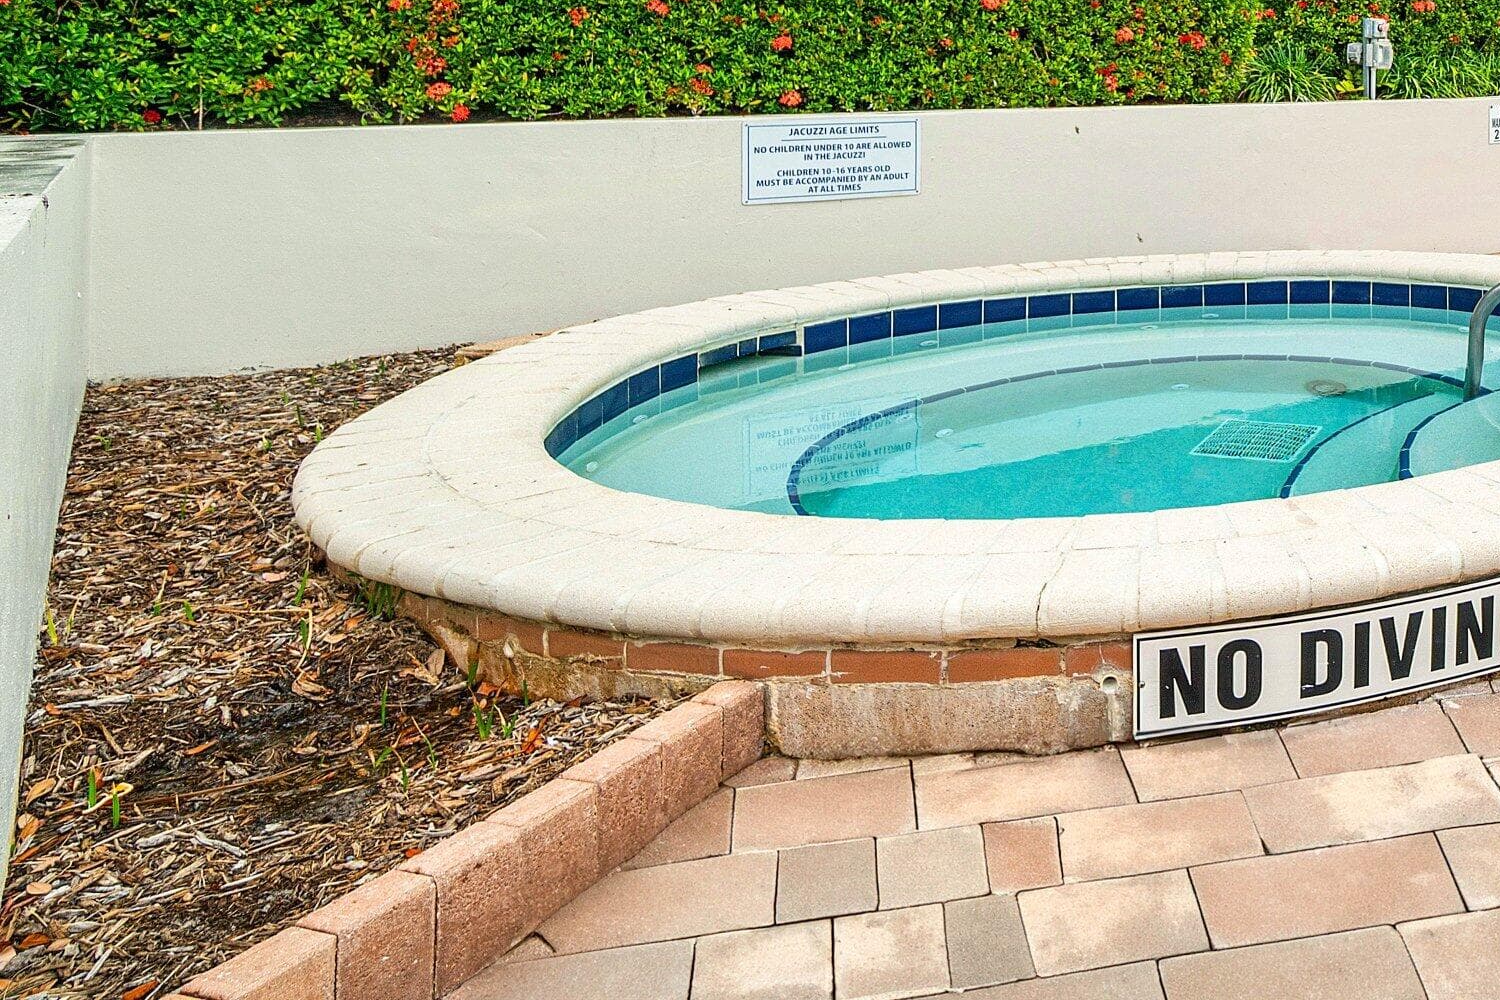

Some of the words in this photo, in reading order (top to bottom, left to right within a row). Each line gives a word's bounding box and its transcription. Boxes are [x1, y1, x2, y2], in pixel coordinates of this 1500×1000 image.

[789, 128, 827, 136] JACUZZI
[829, 127, 847, 135] AGE
[850, 126, 880, 134] LIMITS
[1494, 129, 1500, 140] 2
[769, 144, 812, 153] CHILDREN
[813, 144, 842, 152] UNDER
[873, 141, 912, 149] ALLOWED
[832, 151, 865, 159] JACUZZI
[777, 168, 819, 177] CHILDREN
[756, 179, 781, 187] MUST
[783, 178, 793, 186] BE
[795, 175, 856, 185] ACCOMPANIED
[883, 172, 909, 180] ADULT
[837, 183, 861, 191] TIMES
[1159, 639, 1263, 719] NO
